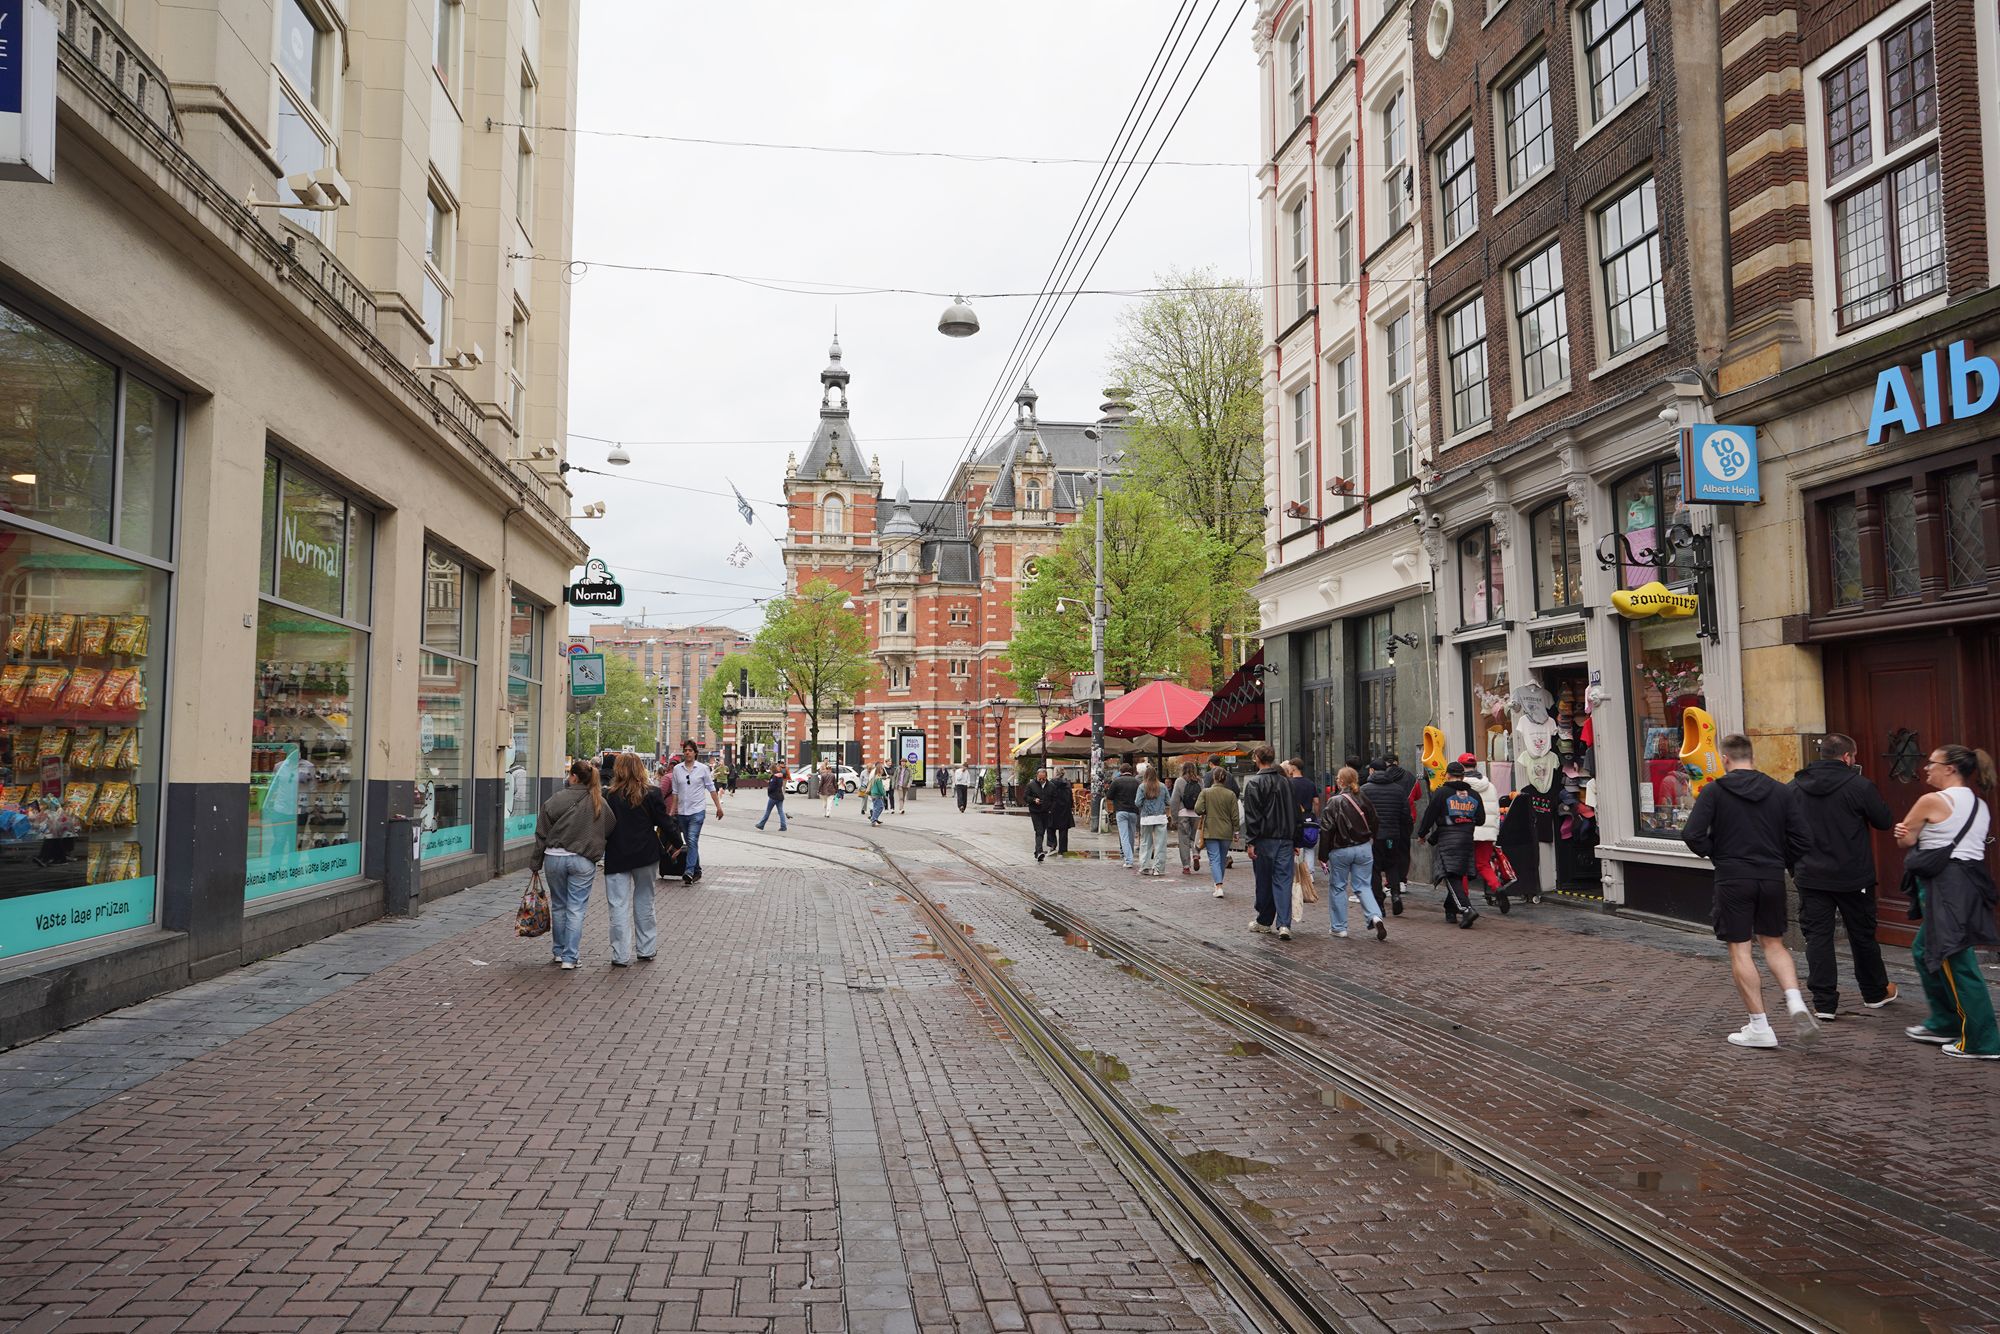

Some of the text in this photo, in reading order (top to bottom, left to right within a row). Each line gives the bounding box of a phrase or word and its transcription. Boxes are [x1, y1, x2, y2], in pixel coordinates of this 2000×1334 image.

[1866, 340, 2000, 446] Alb
[1710, 437, 1735, 457] to
[1719, 451, 1745, 477] go
[1702, 484, 1755, 496] Albert Heijn
[284, 515, 340, 578] Normal
[575, 588, 617, 601] Normal
[1450, 799, 1475, 811] Rhude
[267, 868, 288, 881] merken
[289, 866, 304, 879] tegen
[305, 863, 320, 875] vaste
[319, 860, 330, 872] lage
[330, 858, 348, 872] prijzen
[70, 907, 92, 925] lage
[95, 901, 130, 922] prijzen
